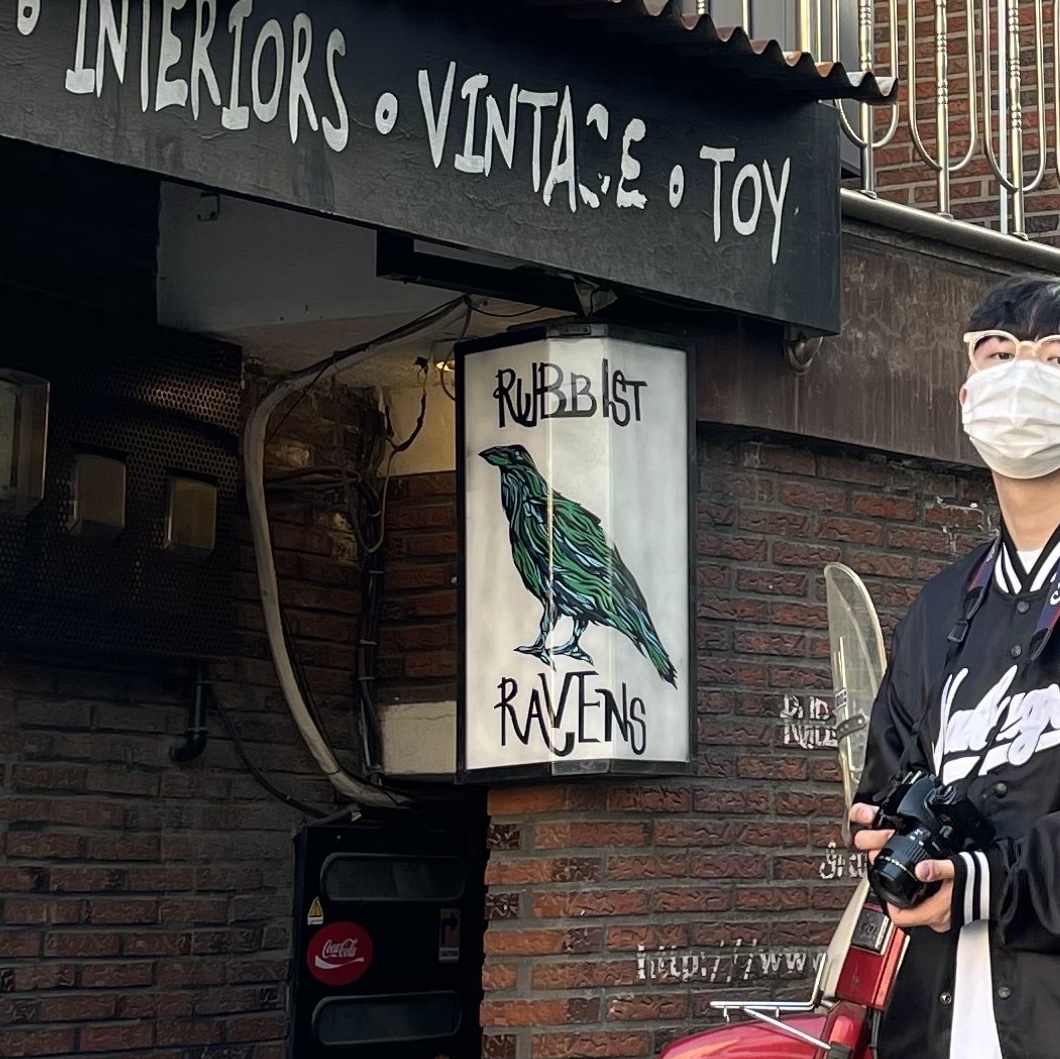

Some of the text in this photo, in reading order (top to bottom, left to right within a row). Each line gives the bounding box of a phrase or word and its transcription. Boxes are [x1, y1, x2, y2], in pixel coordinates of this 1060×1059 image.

[65, 0, 349, 152] INTERIORS
[699, 145, 791, 266] TOY
[493, 358, 649, 429] RUBBIST
[493, 670, 648, 758] RAVENS
